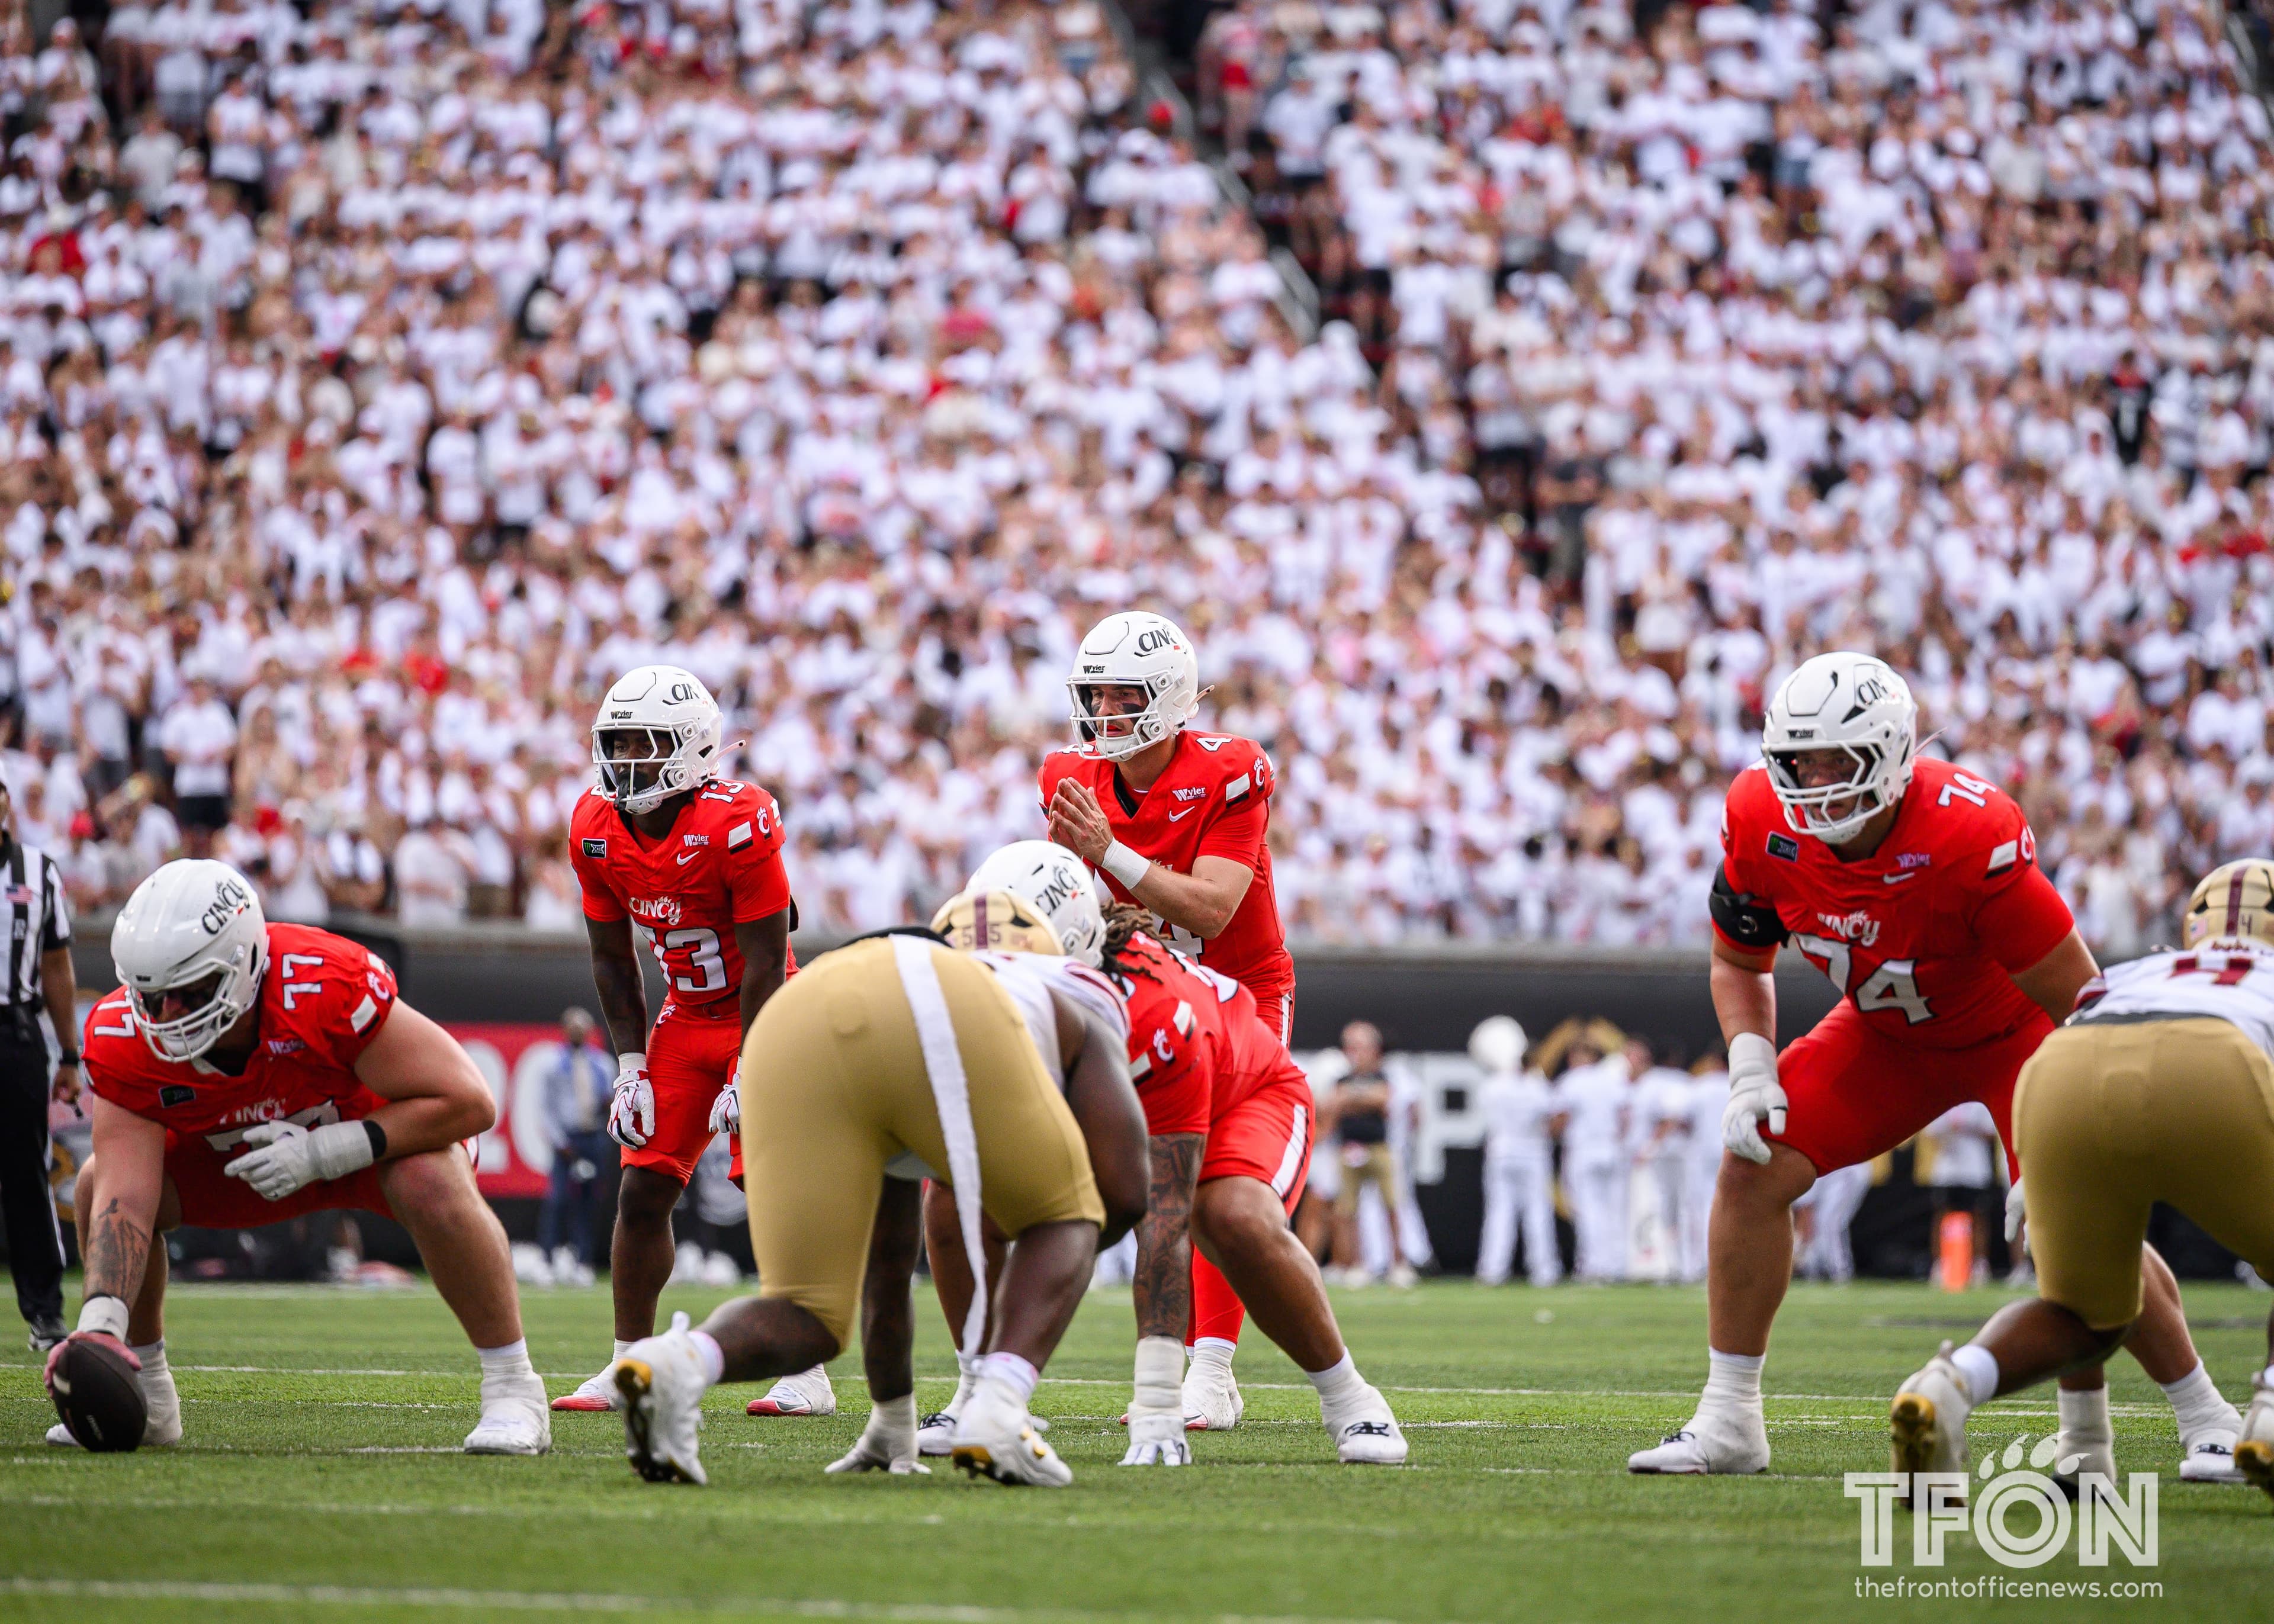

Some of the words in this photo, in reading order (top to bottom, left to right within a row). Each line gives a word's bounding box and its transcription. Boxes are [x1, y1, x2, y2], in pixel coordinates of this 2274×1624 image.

[1195, 737, 1234, 752] 4
[1172, 787, 1206, 802] Wyler
[1937, 771, 1998, 808] 74
[683, 834, 710, 847] Wyler
[281, 953, 325, 1010] 77
[1790, 931, 1935, 1025] 74
